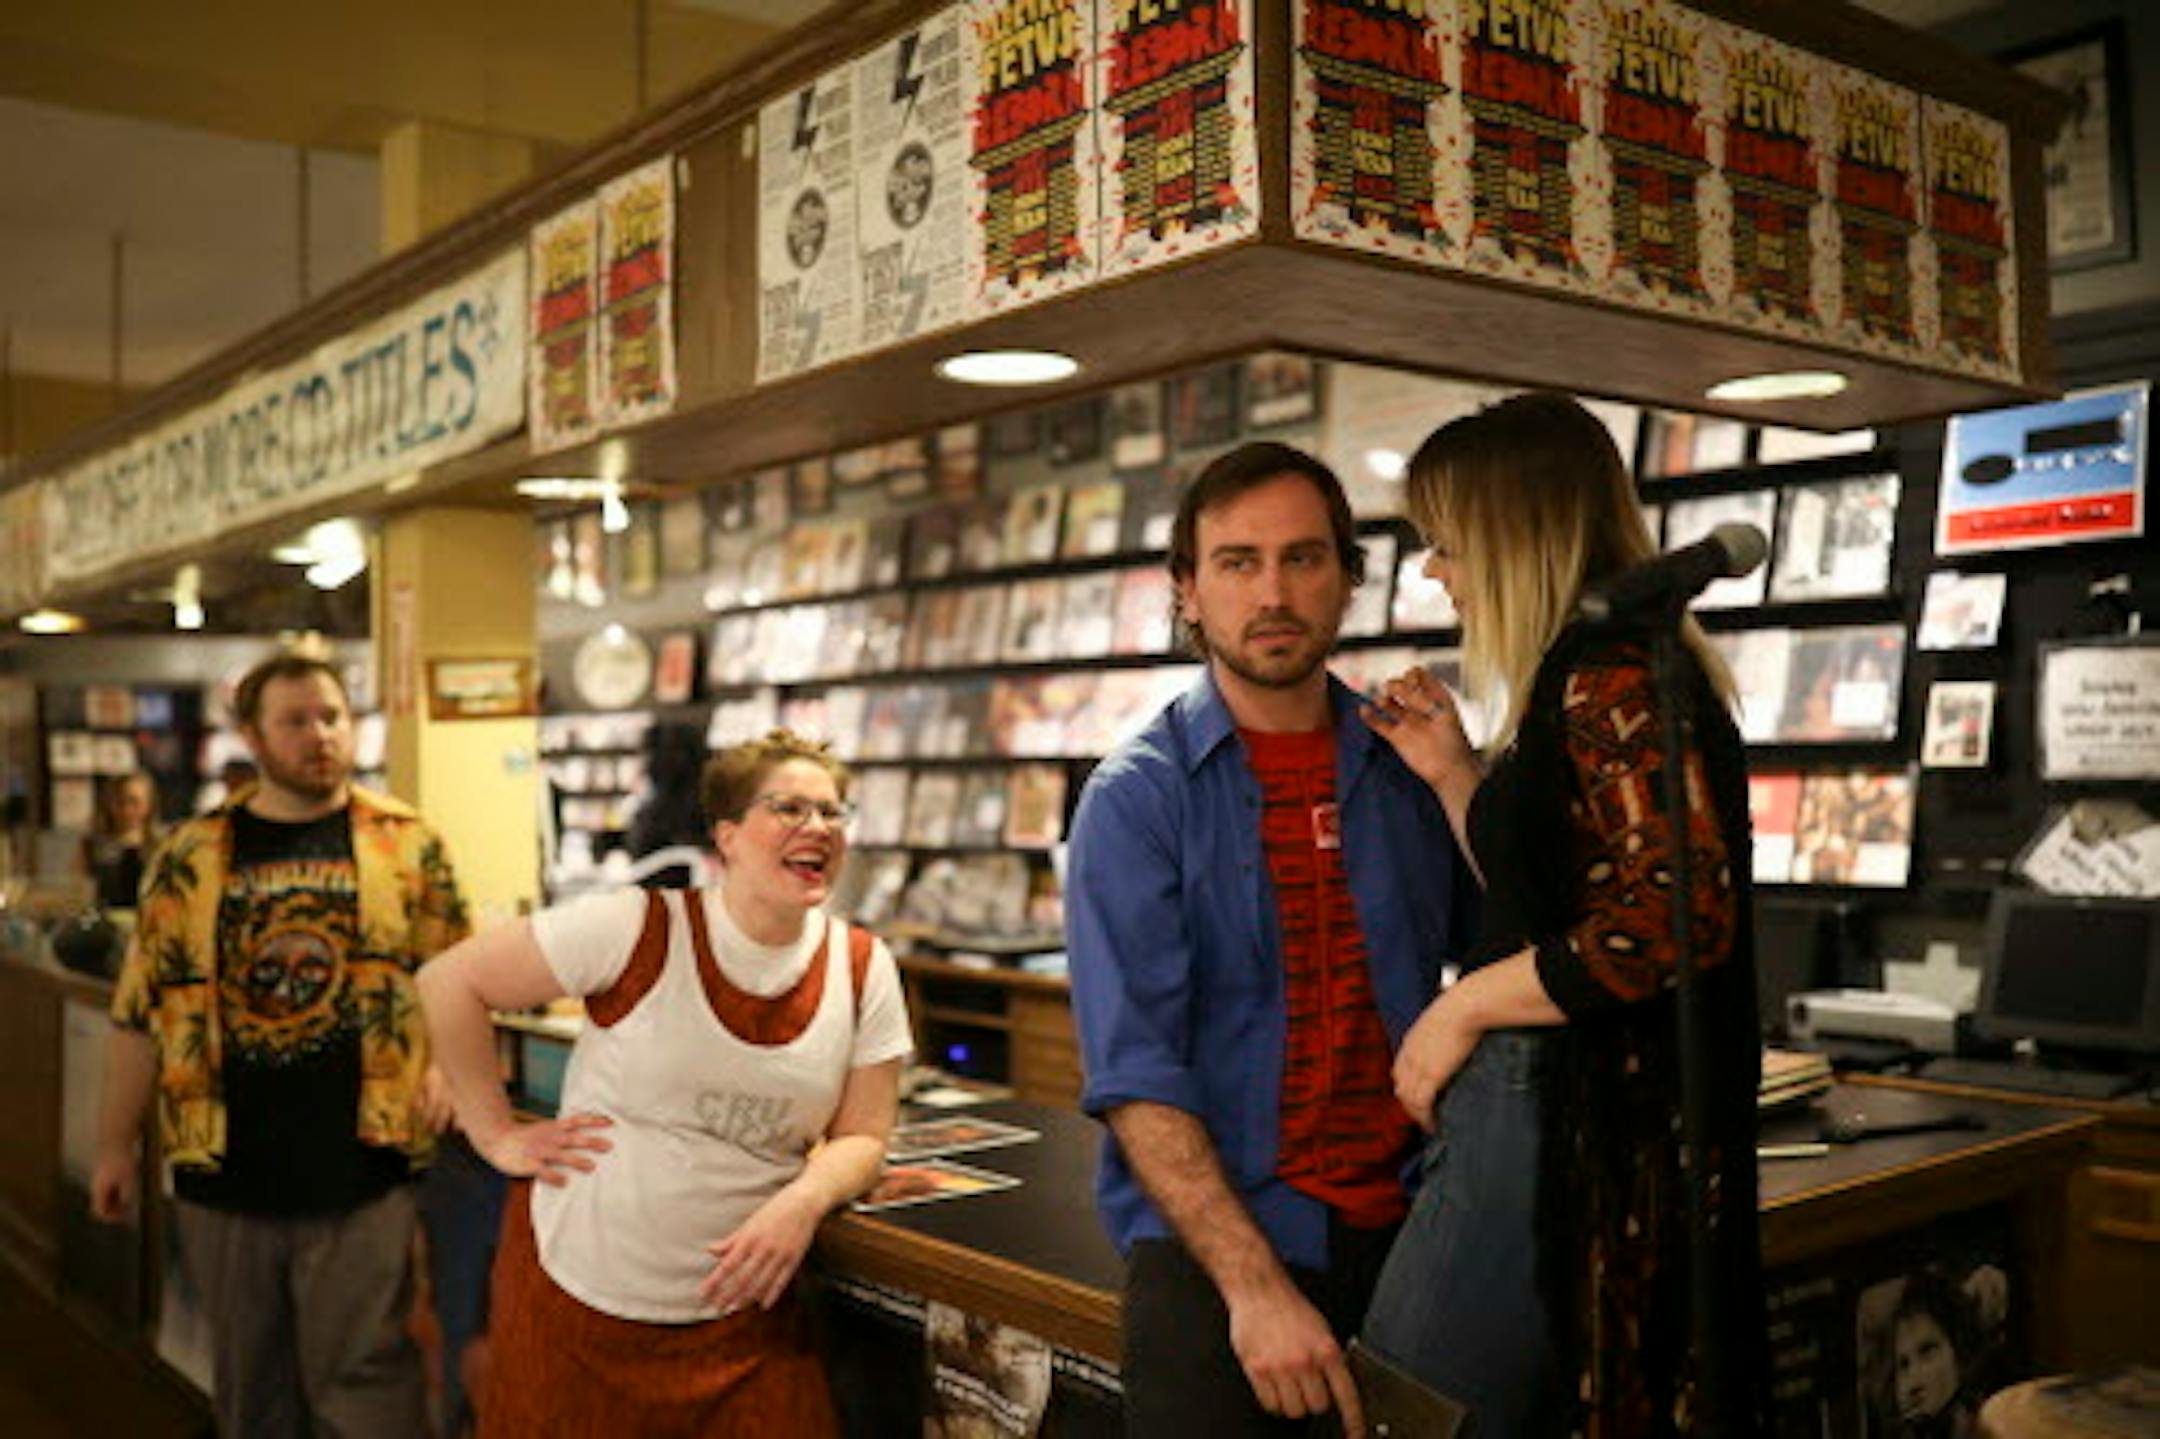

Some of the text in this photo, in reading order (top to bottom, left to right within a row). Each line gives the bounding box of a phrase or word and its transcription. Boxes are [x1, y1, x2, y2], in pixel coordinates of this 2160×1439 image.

[203, 392, 283, 514] MORE
[287, 376, 334, 490] CD
[341, 300, 476, 475] TITLES
